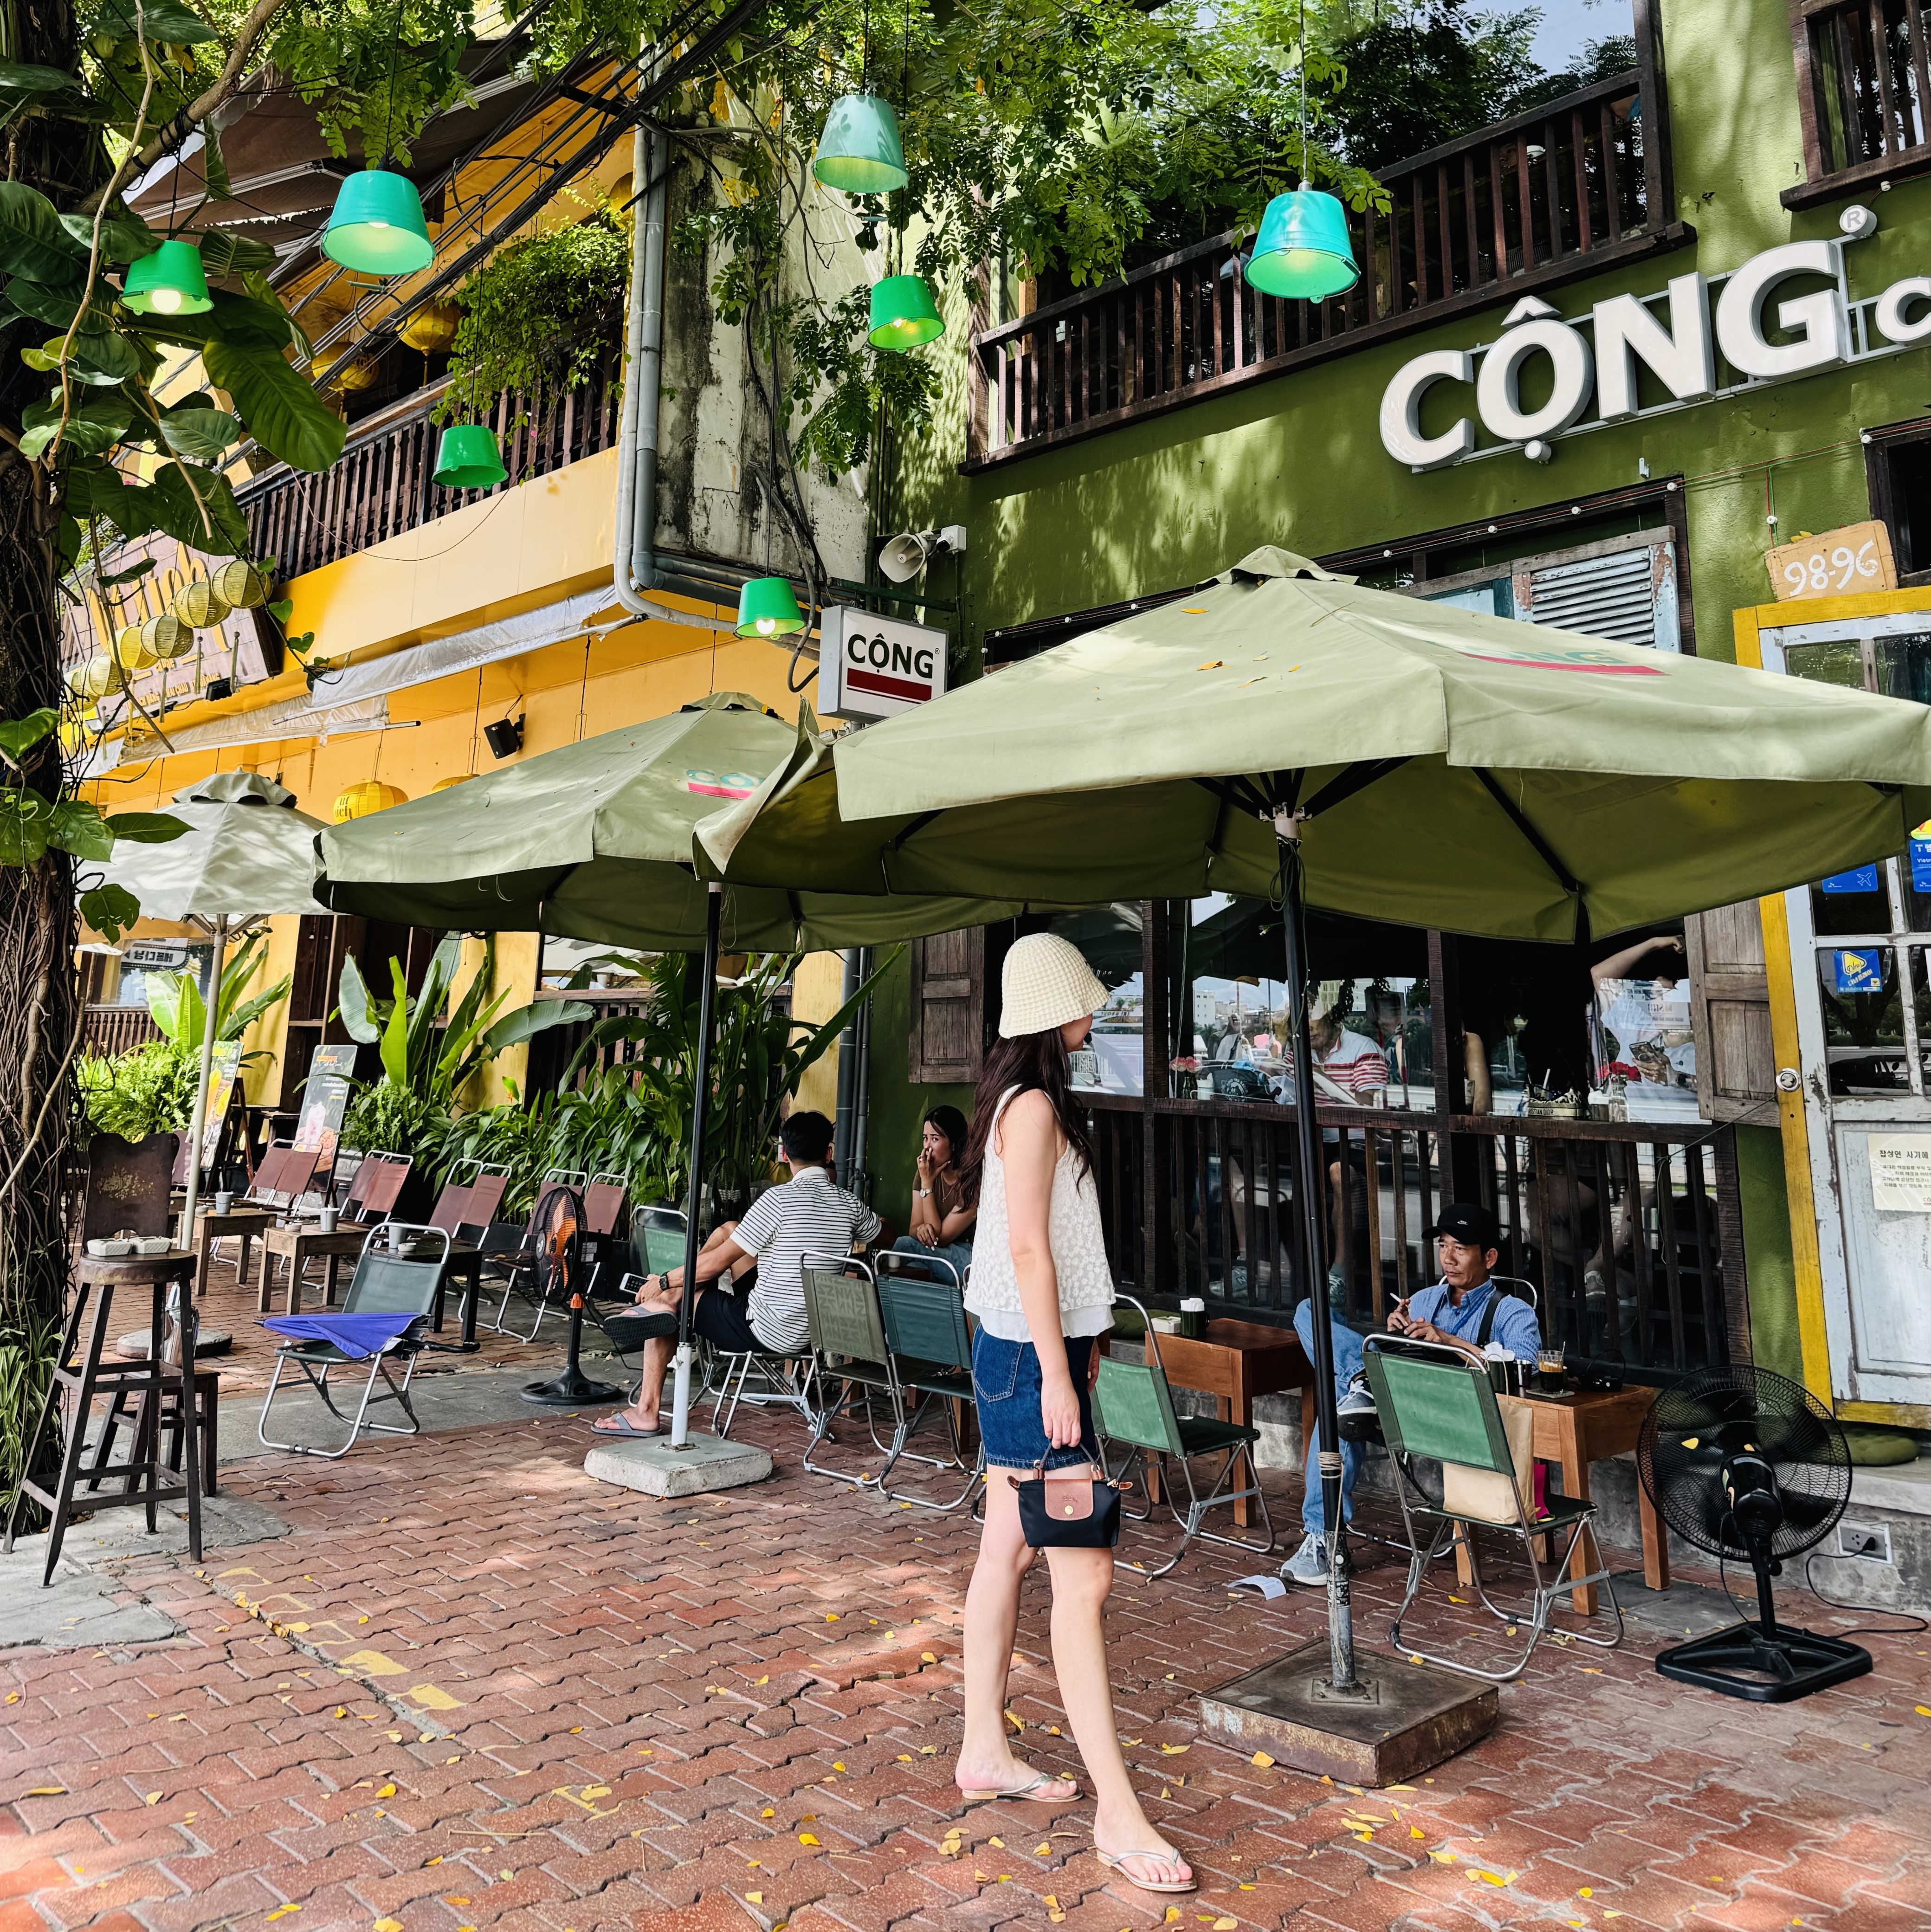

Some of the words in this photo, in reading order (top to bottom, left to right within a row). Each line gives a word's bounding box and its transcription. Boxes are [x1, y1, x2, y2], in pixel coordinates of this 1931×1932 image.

[1380, 240, 1846, 466] CỘNG
[1784, 540, 1878, 597] 98-96
[848, 633, 933, 679] CỘNG
